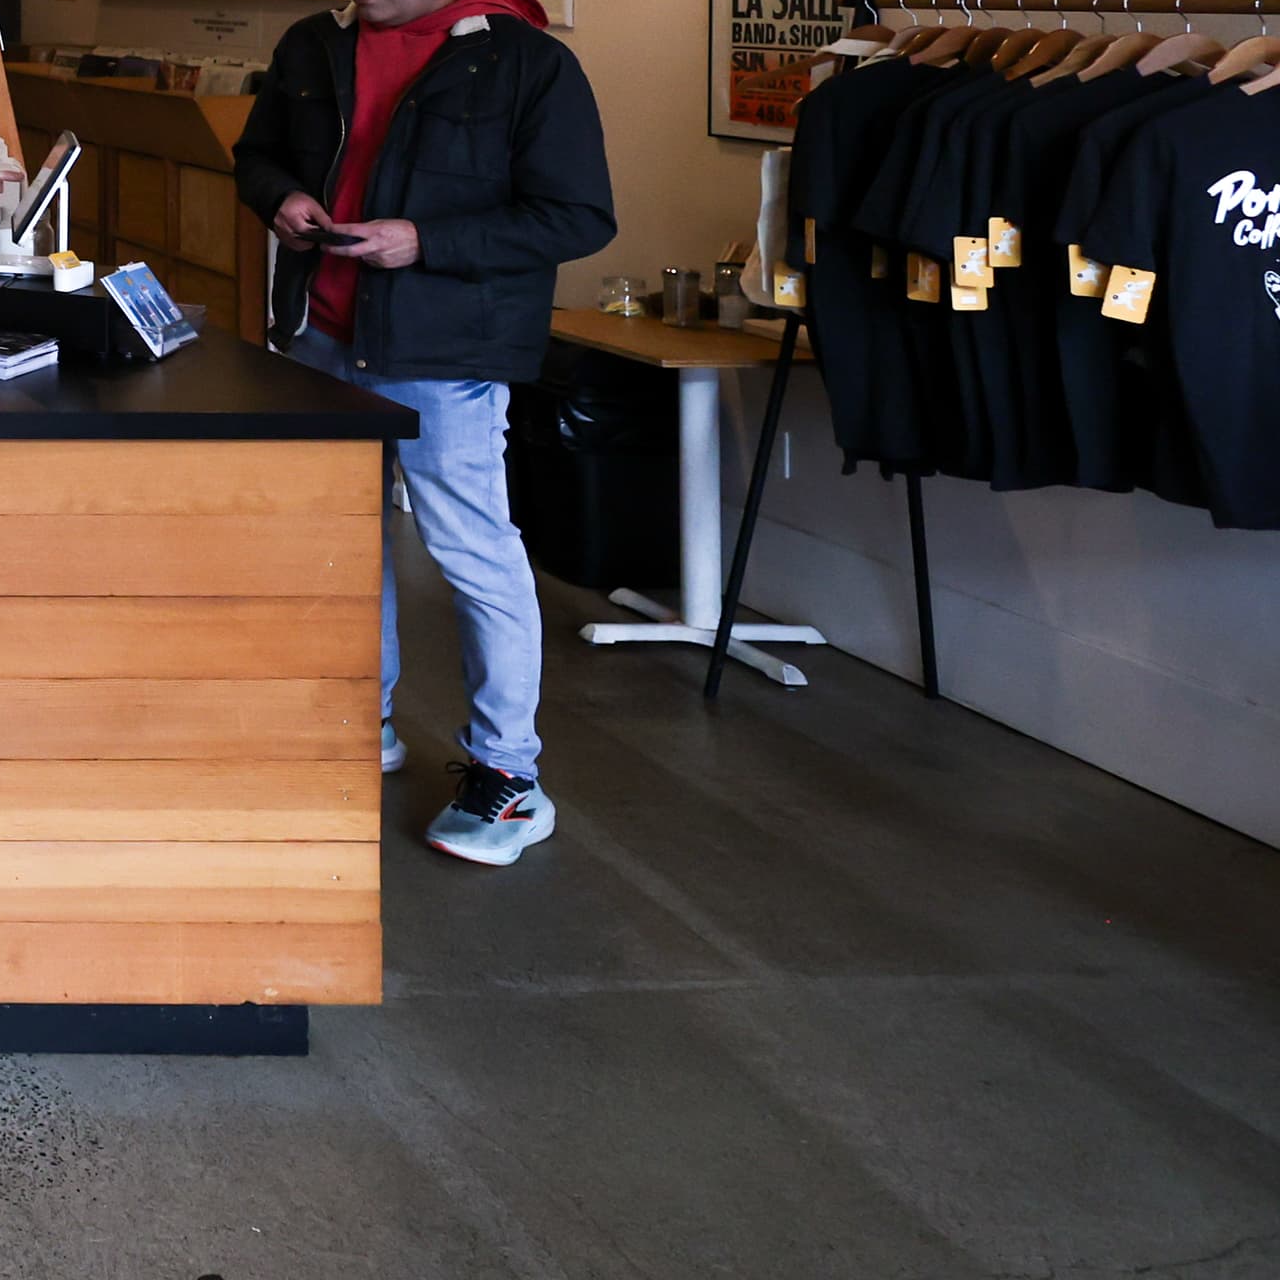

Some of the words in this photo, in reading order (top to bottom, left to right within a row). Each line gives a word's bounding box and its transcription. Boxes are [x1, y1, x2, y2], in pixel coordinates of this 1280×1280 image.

[732, 22, 776, 45] BAND
[778, 31, 786, 45] &
[790, 23, 842, 48] SHOW
